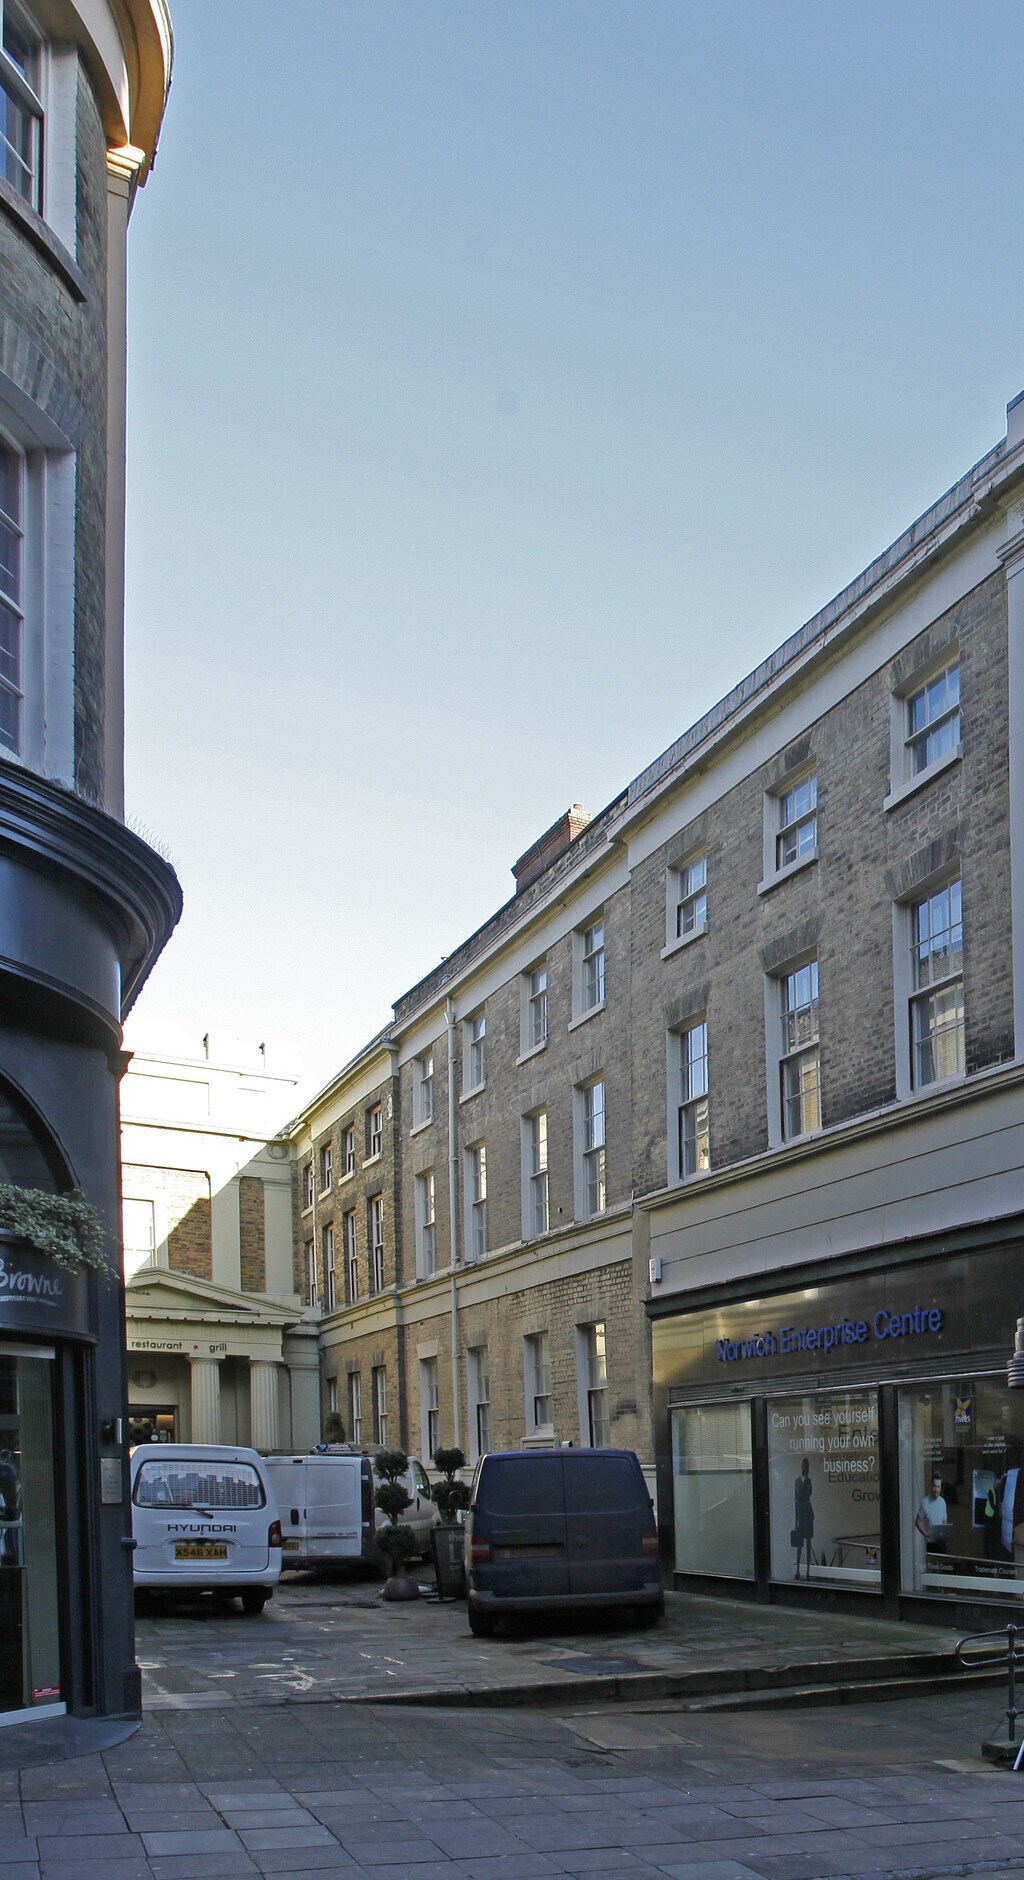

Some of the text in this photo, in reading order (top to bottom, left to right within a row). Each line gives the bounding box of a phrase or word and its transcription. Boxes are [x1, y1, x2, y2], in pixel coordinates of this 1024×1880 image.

[715, 1305, 942, 1362] Norwich Enterprise Centre
[131, 1340, 227, 1353] restaurant grill
[771, 1406, 875, 1430] Can you see yourself
[789, 1434, 875, 1453] running your own
[823, 1456, 875, 1473] business?
[167, 1524, 237, 1533] HYUNDAI
